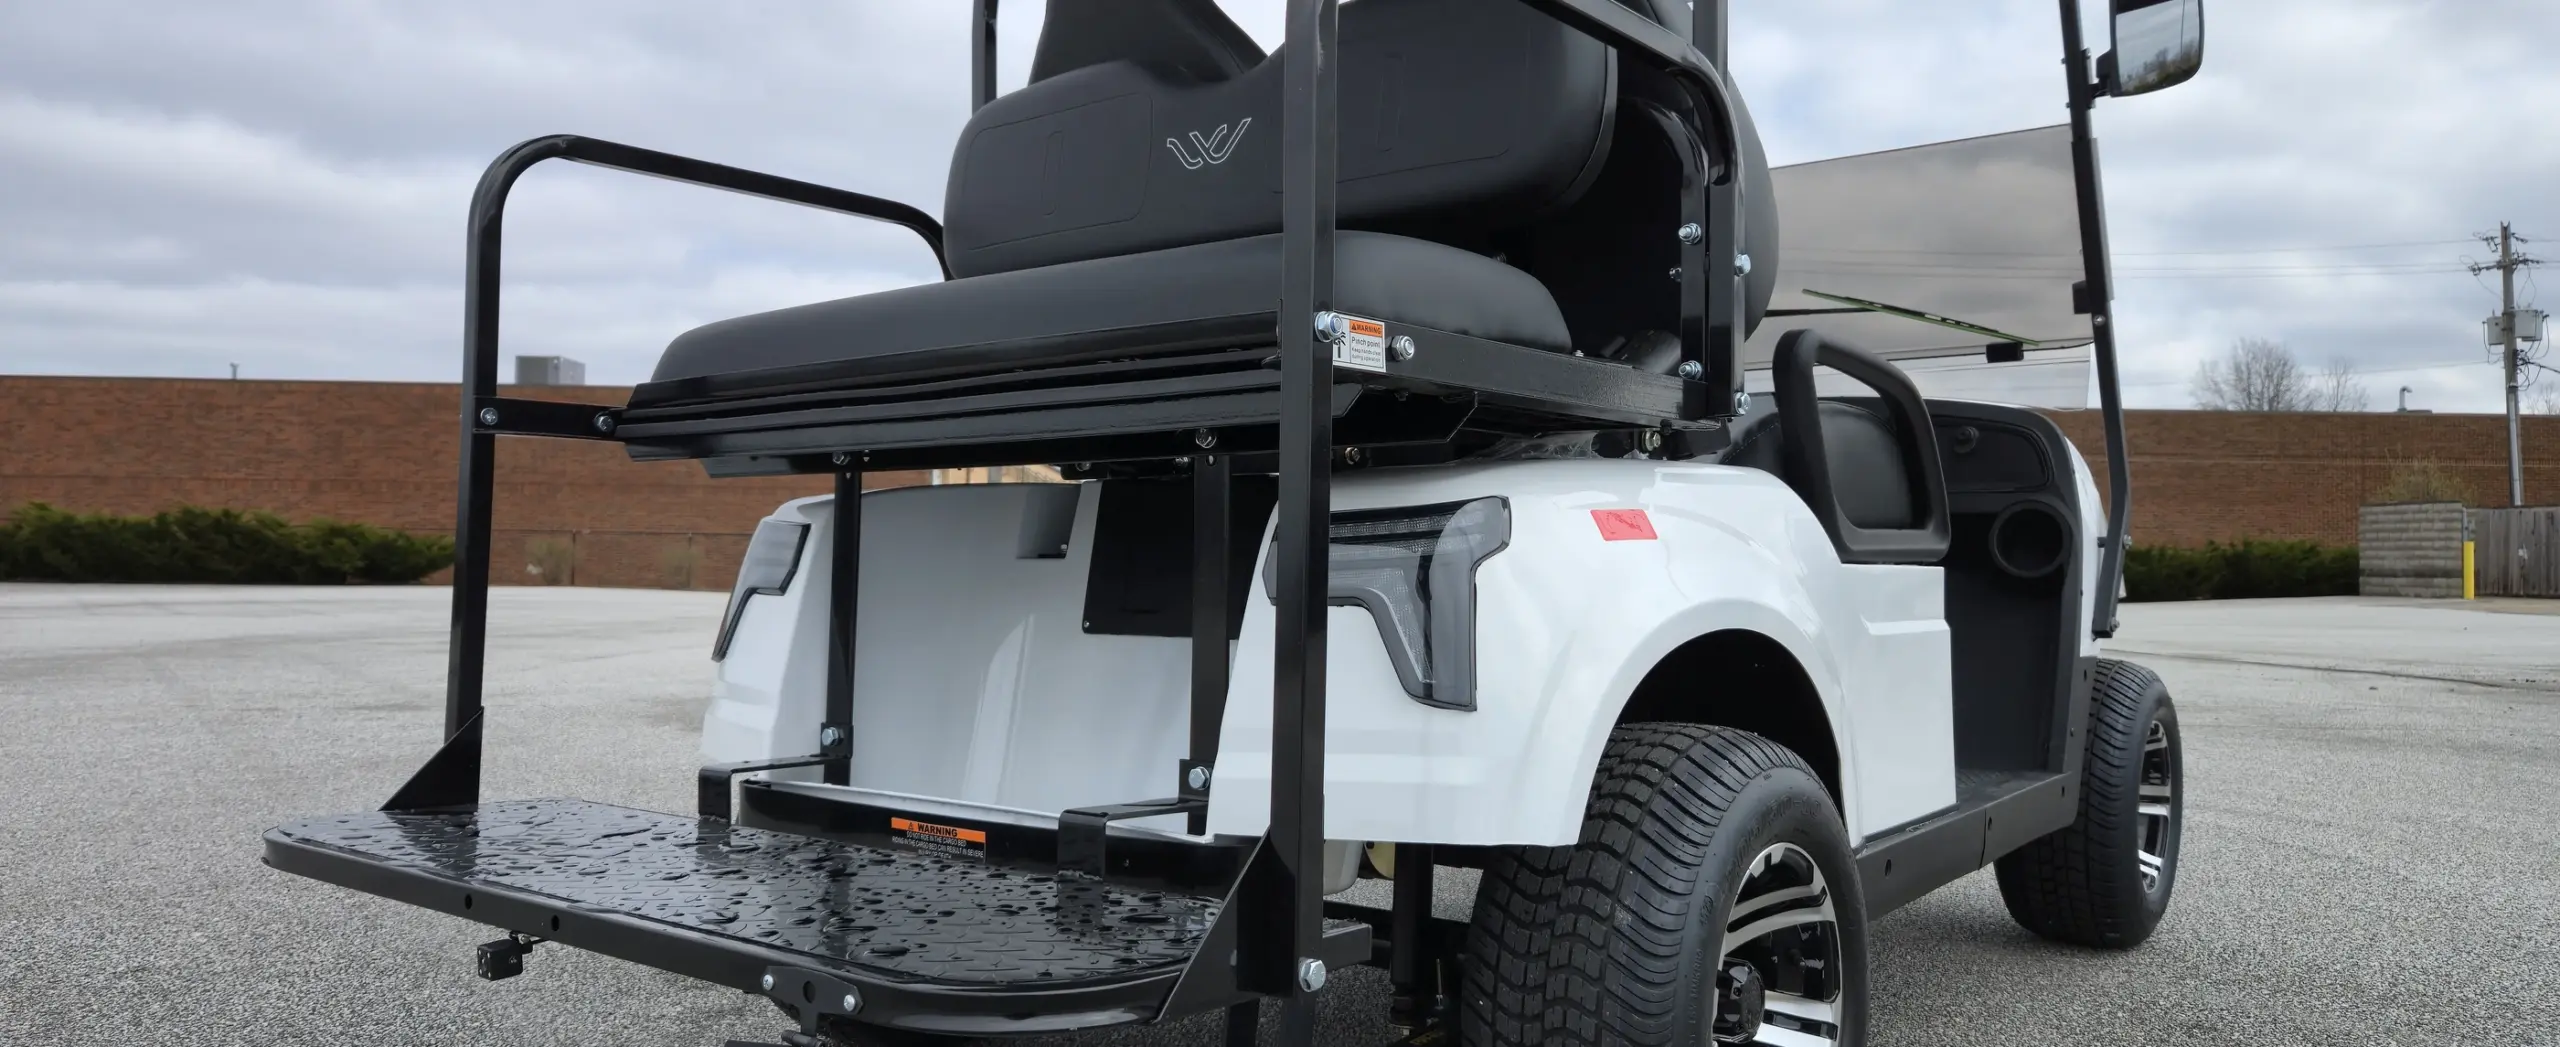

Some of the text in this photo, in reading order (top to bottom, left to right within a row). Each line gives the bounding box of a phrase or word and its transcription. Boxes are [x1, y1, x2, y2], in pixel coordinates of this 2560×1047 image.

[1357, 324, 1380, 334] WARNING
[1352, 337, 1366, 345] Pinch
[918, 823, 957, 837] WARNING
[943, 837, 957, 845] CARGO
[929, 842, 938, 850] BED
[938, 844, 946, 852] CAN
[947, 845, 962, 854] RESULT
[967, 849, 984, 858] SEVERE
